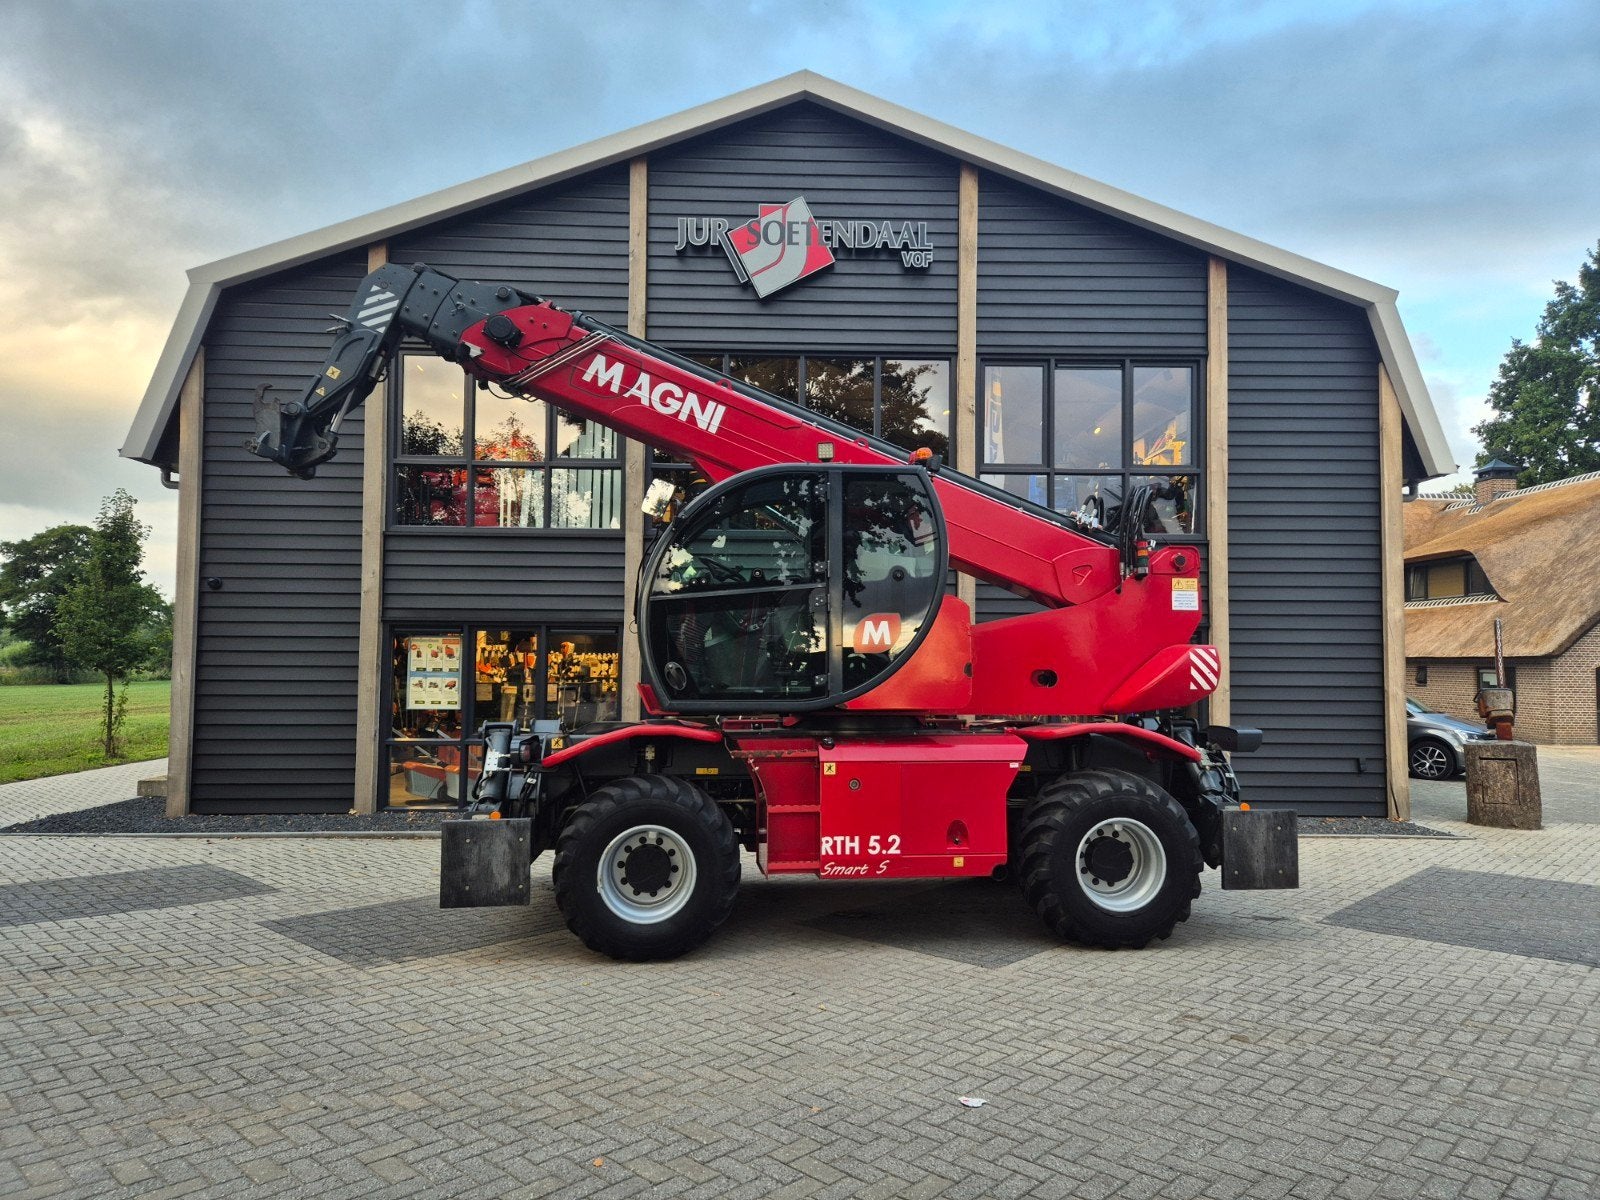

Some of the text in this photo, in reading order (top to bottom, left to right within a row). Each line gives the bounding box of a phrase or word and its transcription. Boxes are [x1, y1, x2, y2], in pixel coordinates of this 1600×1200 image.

[746, 219, 933, 250] SOETENDAAL
[901, 251, 933, 268] VOF
[581, 353, 727, 435] MAGNI
[862, 620, 891, 645] M
[821, 834, 901, 855] RTH 5.2
[820, 859, 890, 876] Smart S
